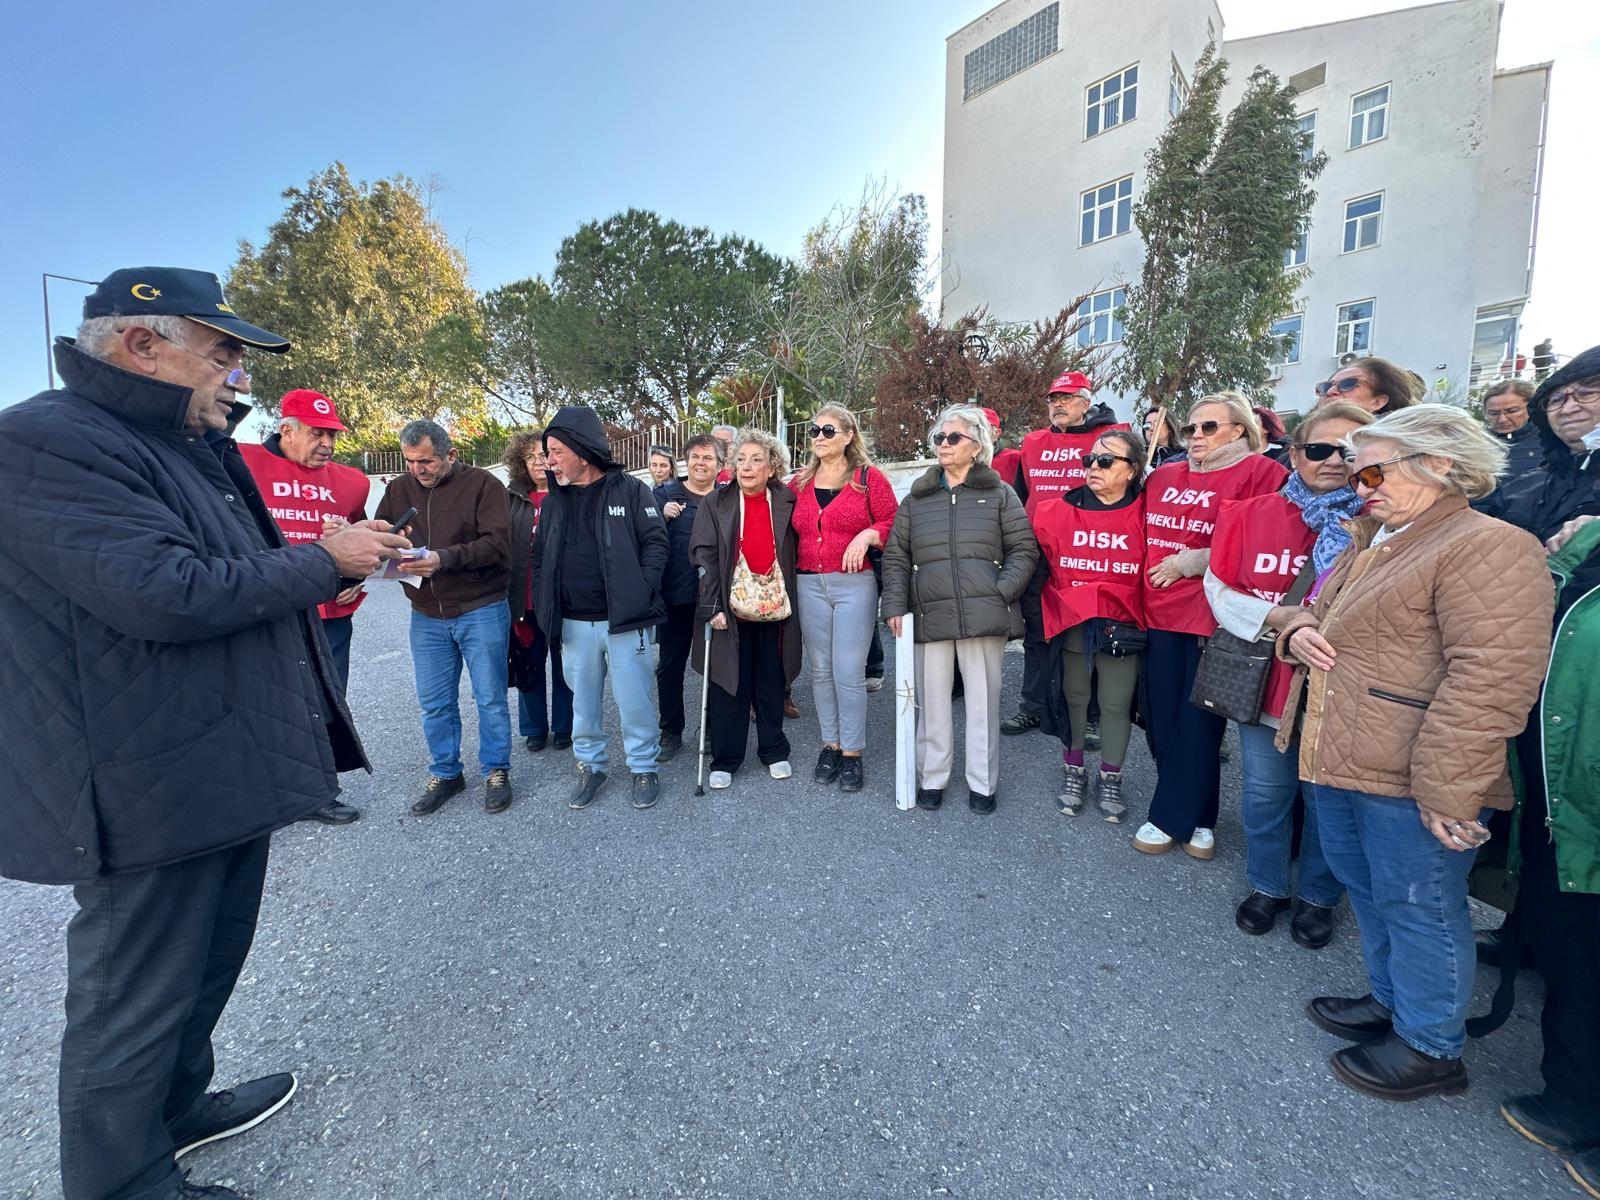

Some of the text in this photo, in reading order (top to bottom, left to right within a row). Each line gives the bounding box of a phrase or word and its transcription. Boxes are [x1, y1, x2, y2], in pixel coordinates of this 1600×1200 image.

[1040, 448, 1083, 462] DİSK
[1029, 467, 1087, 479] EMEKLİ SEN
[272, 479, 336, 504] DİSK
[1160, 486, 1217, 508] DİSK
[267, 507, 320, 522] MEKLİ
[1072, 529, 1129, 550] DİSK
[1059, 556, 1139, 574] EMEKLİ SEN
[1253, 548, 1309, 576] DİS
